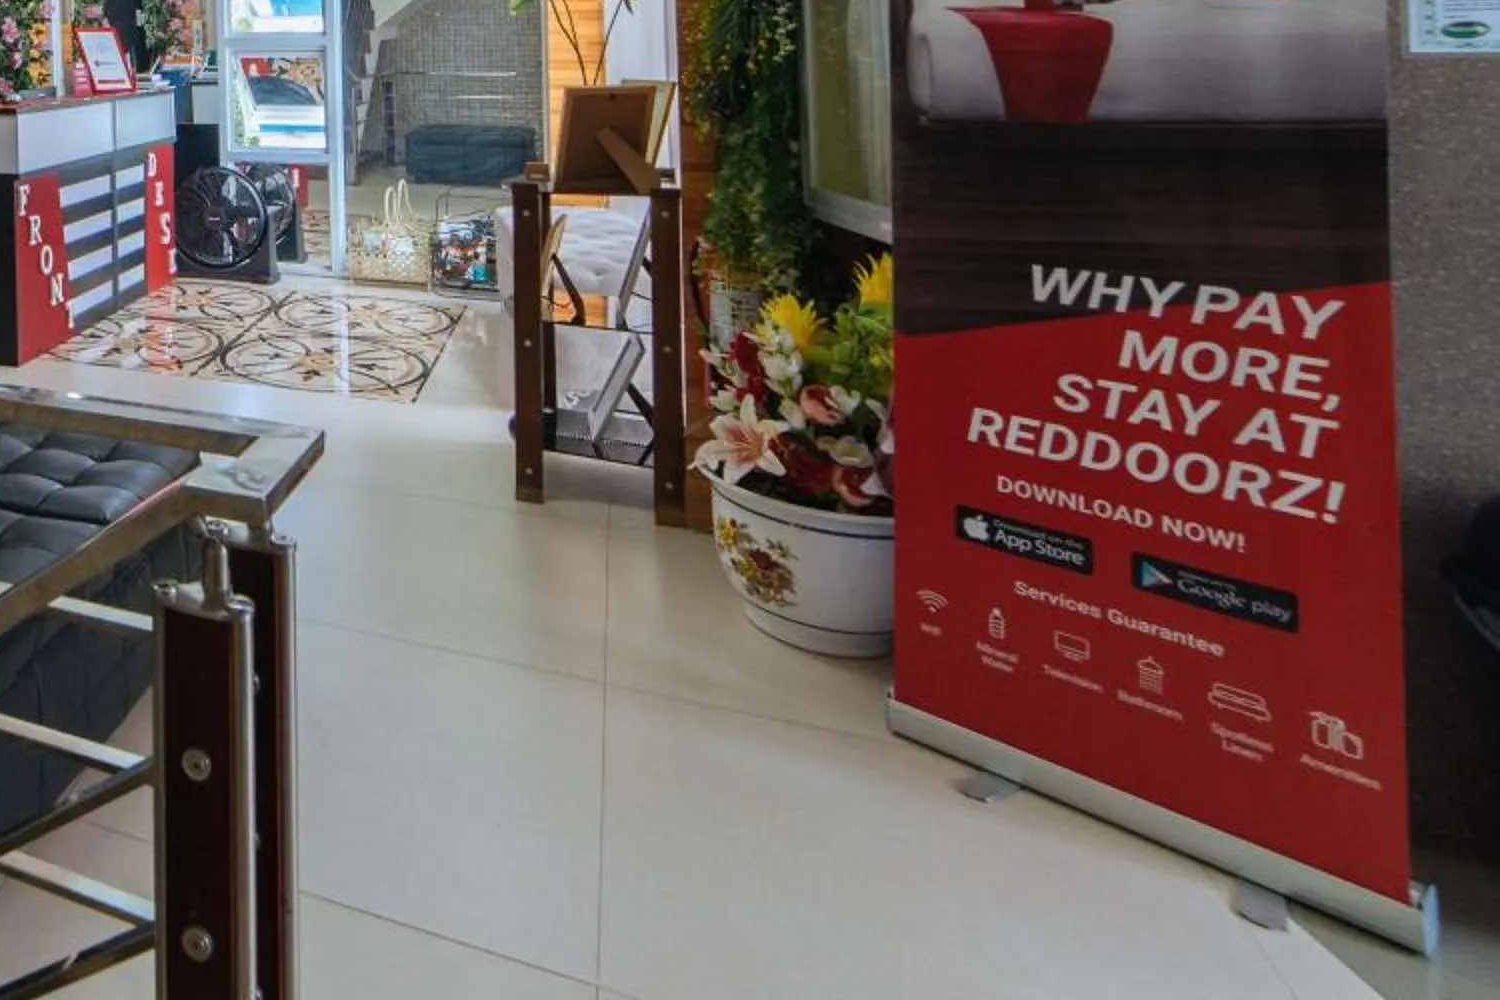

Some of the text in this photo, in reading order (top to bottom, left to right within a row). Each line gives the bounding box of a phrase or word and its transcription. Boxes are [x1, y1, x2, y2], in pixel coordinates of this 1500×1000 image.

[18, 183, 75, 329] FRONT
[1031, 263, 1346, 340] WHY PAY
[1117, 328, 1342, 410] MORE,
[1053, 373, 1340, 459] STAY AT
[966, 407, 1347, 525] REDDOORZ!
[994, 530, 1032, 553] App
[1034, 538, 1086, 566] Store
[996, 474, 1246, 554] DOWNLOAD NOW!
[1014, 580, 1226, 659] Services Guarantee
[1176, 578, 1247, 609] Google
